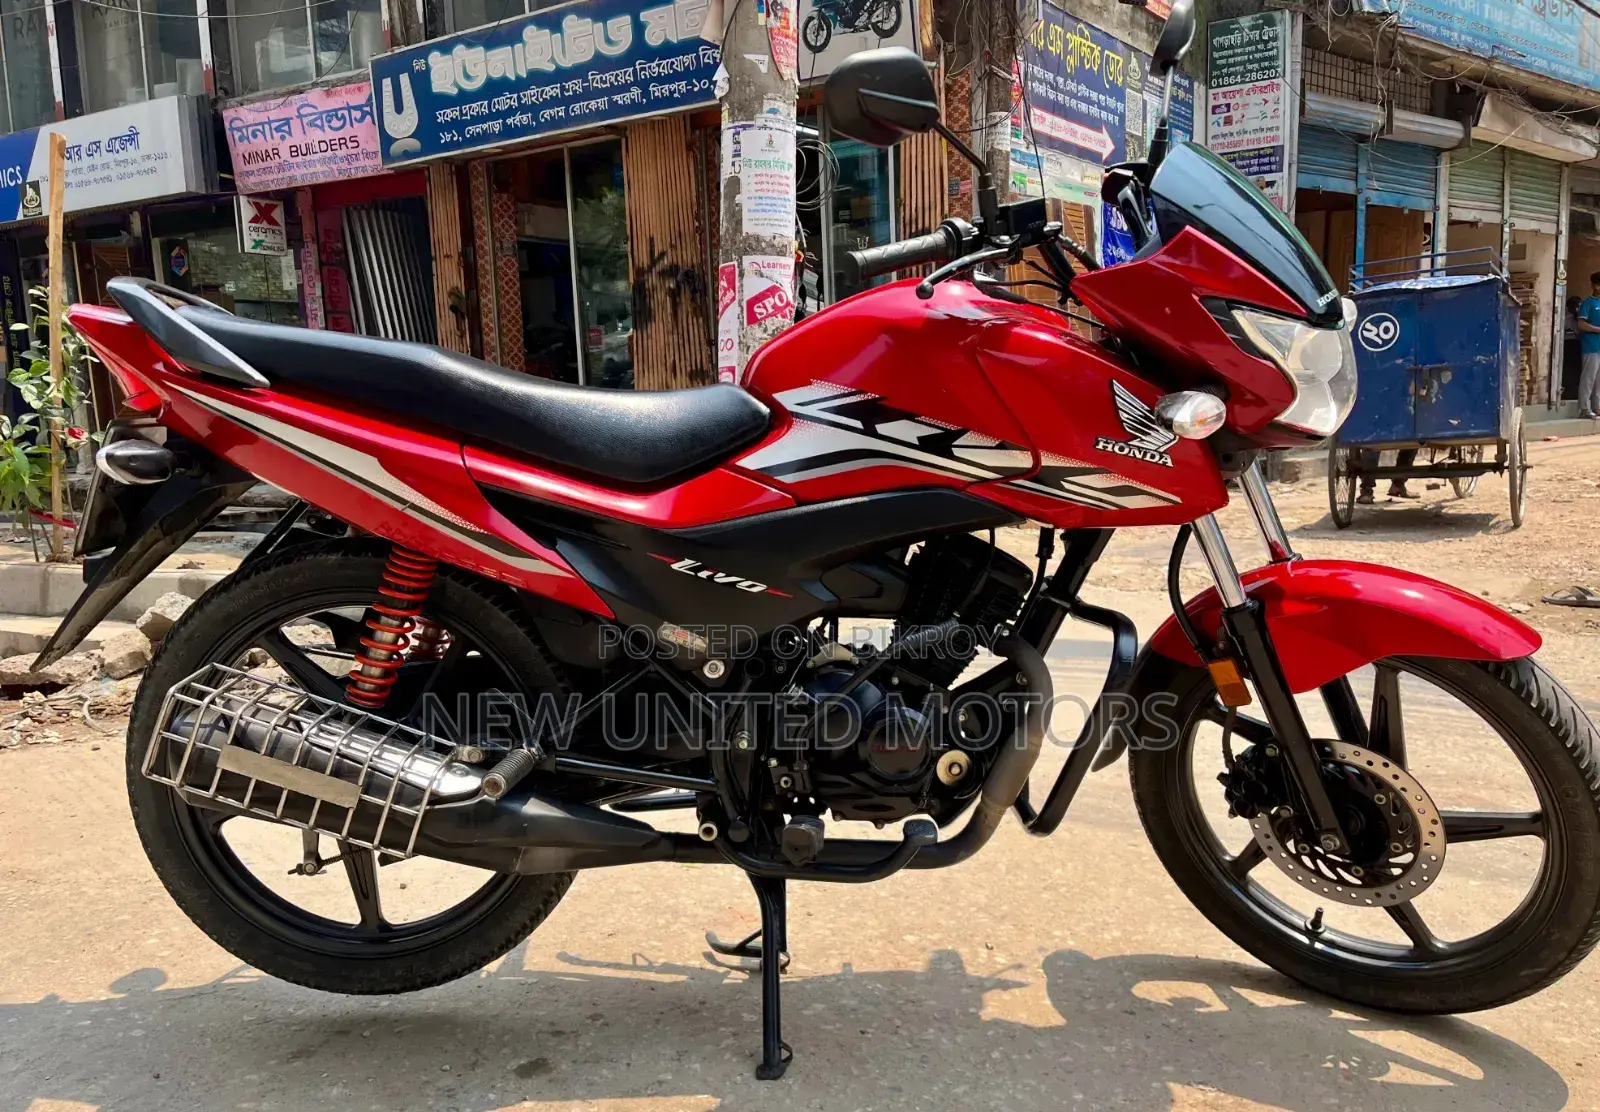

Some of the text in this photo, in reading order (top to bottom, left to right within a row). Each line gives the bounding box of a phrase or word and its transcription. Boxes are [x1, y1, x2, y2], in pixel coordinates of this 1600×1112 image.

[412, 58, 427, 74] নিউ
[428, 14, 633, 96] ইউনাইটেড
[435, 106, 460, 125] সকল
[461, 100, 489, 120] প্রকার
[491, 92, 518, 116] মোটর
[521, 83, 561, 106] সাইকেল
[563, 66, 635, 98] ক্রয়-বিক্রয়ের
[636, 52, 697, 82] নির্ভরযোগ্য
[1211, 68, 1282, 87] 01864-286207
[228, 116, 293, 148] মিনার
[465, 118, 503, 139] সেনপাড়া
[539, 106, 566, 124] বেগম
[569, 96, 609, 117] রোকেয়া
[242, 135, 360, 166] MINAR BUILDERS
[248, 225, 283, 236] ceramics
[1095, 437, 1174, 468] HONDA
